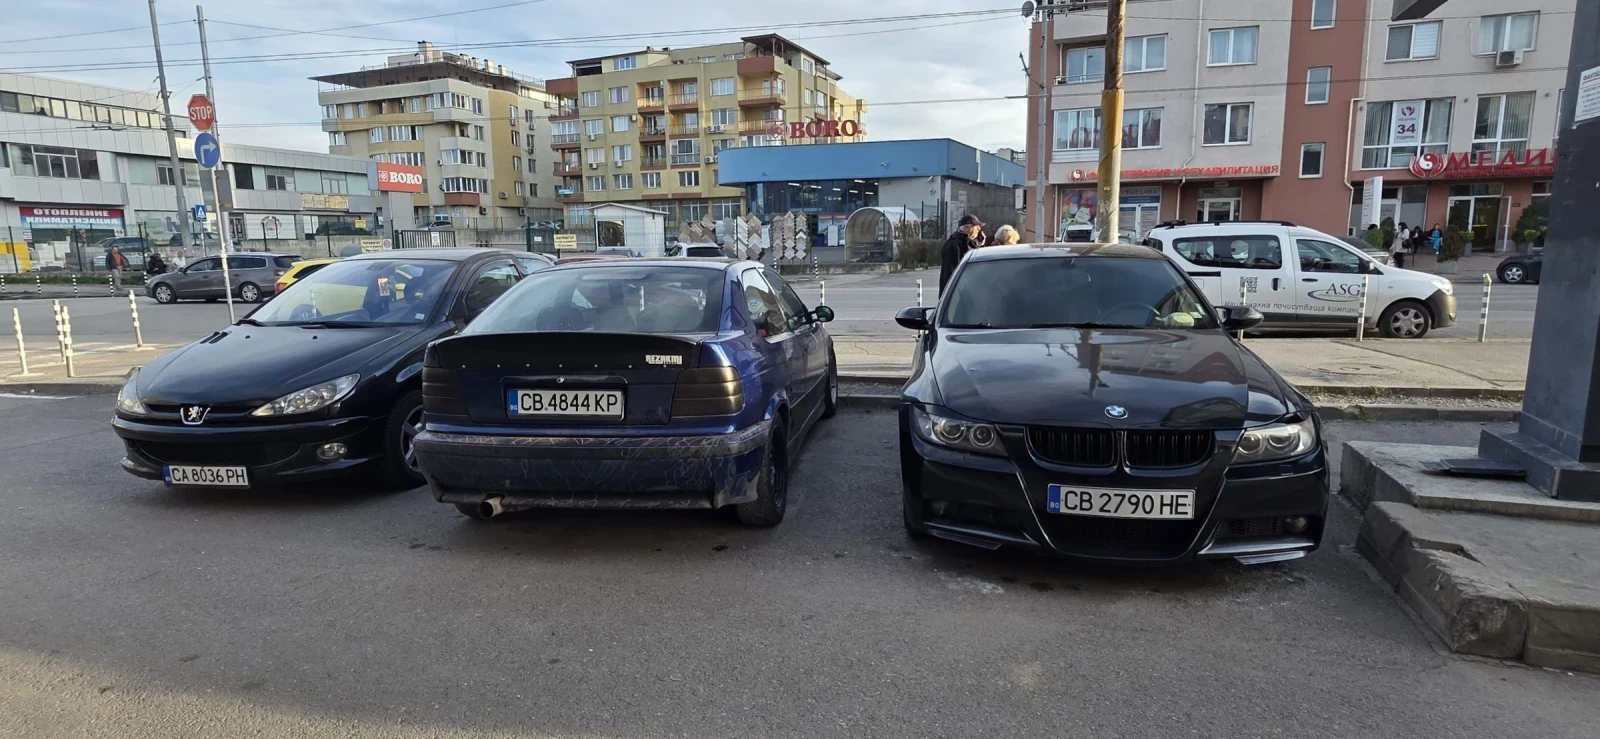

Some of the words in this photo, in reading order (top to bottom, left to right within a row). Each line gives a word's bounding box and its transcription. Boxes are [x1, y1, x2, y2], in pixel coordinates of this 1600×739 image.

[190, 106, 212, 120] STOP
[789, 119, 858, 138] BORO
[1397, 123, 1416, 134] 34
[389, 172, 423, 185] BORO
[33, 208, 110, 217] ОТОПЛЕНИЕ
[1325, 283, 1360, 296] ASG
[1273, 303, 1325, 312] почистваща
[521, 393, 544, 412] CB
[548, 393, 590, 412] 4844
[594, 394, 618, 412] KP
[171, 468, 190, 482] CA
[191, 468, 224, 483] 8036
[225, 469, 246, 483] PH
[1064, 490, 1093, 511] CB
[1099, 493, 1155, 515] 2790
[1160, 495, 1189, 515] HE
